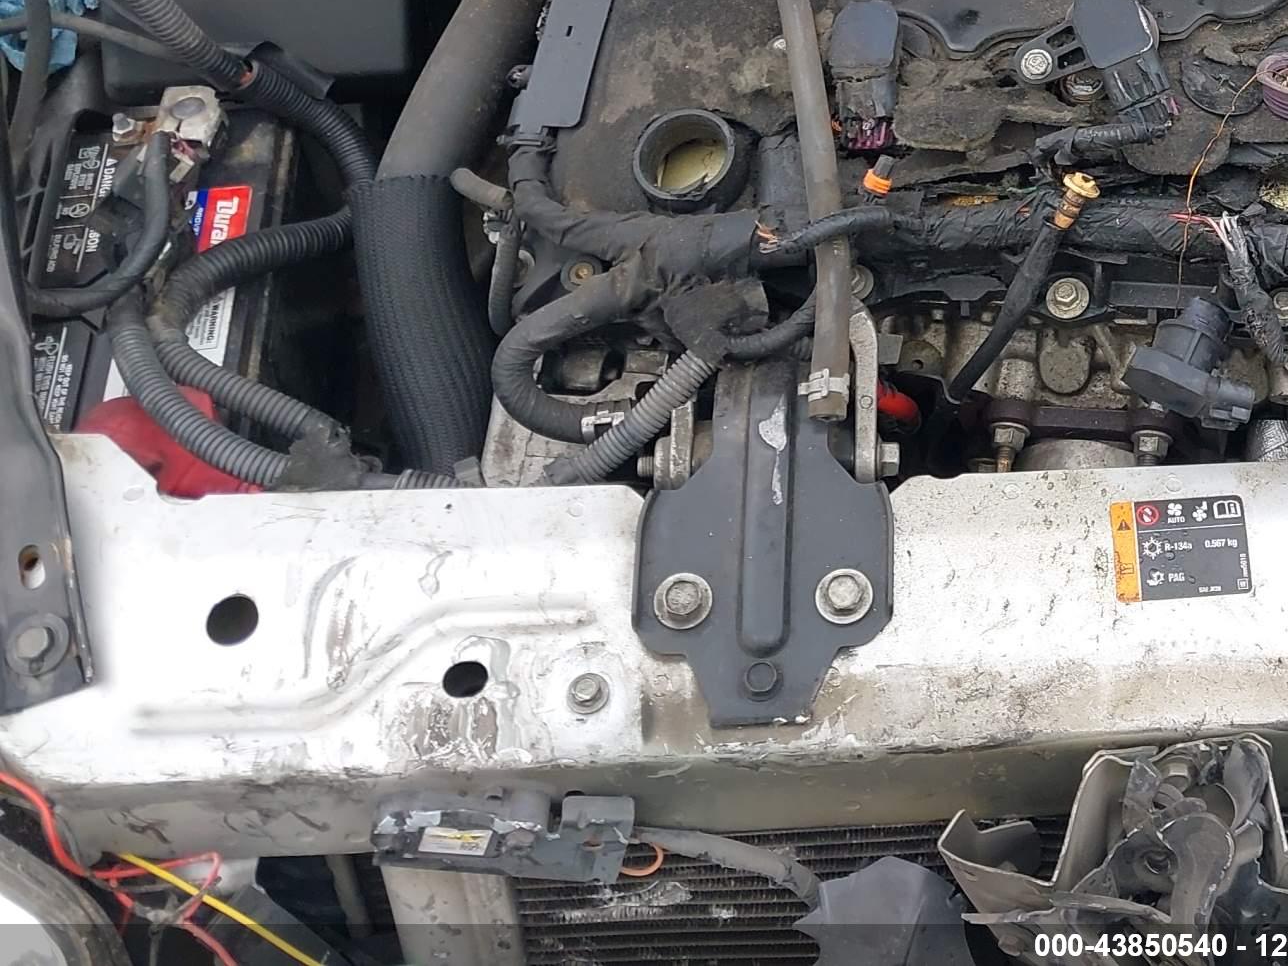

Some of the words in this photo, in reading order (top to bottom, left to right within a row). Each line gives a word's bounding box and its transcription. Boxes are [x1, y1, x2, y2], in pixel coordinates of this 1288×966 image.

[1167, 516, 1185, 524] AUTO
[1164, 542, 1193, 551] R-134a
[1227, 538, 1238, 548] kg
[1168, 572, 1185, 582] PAG
